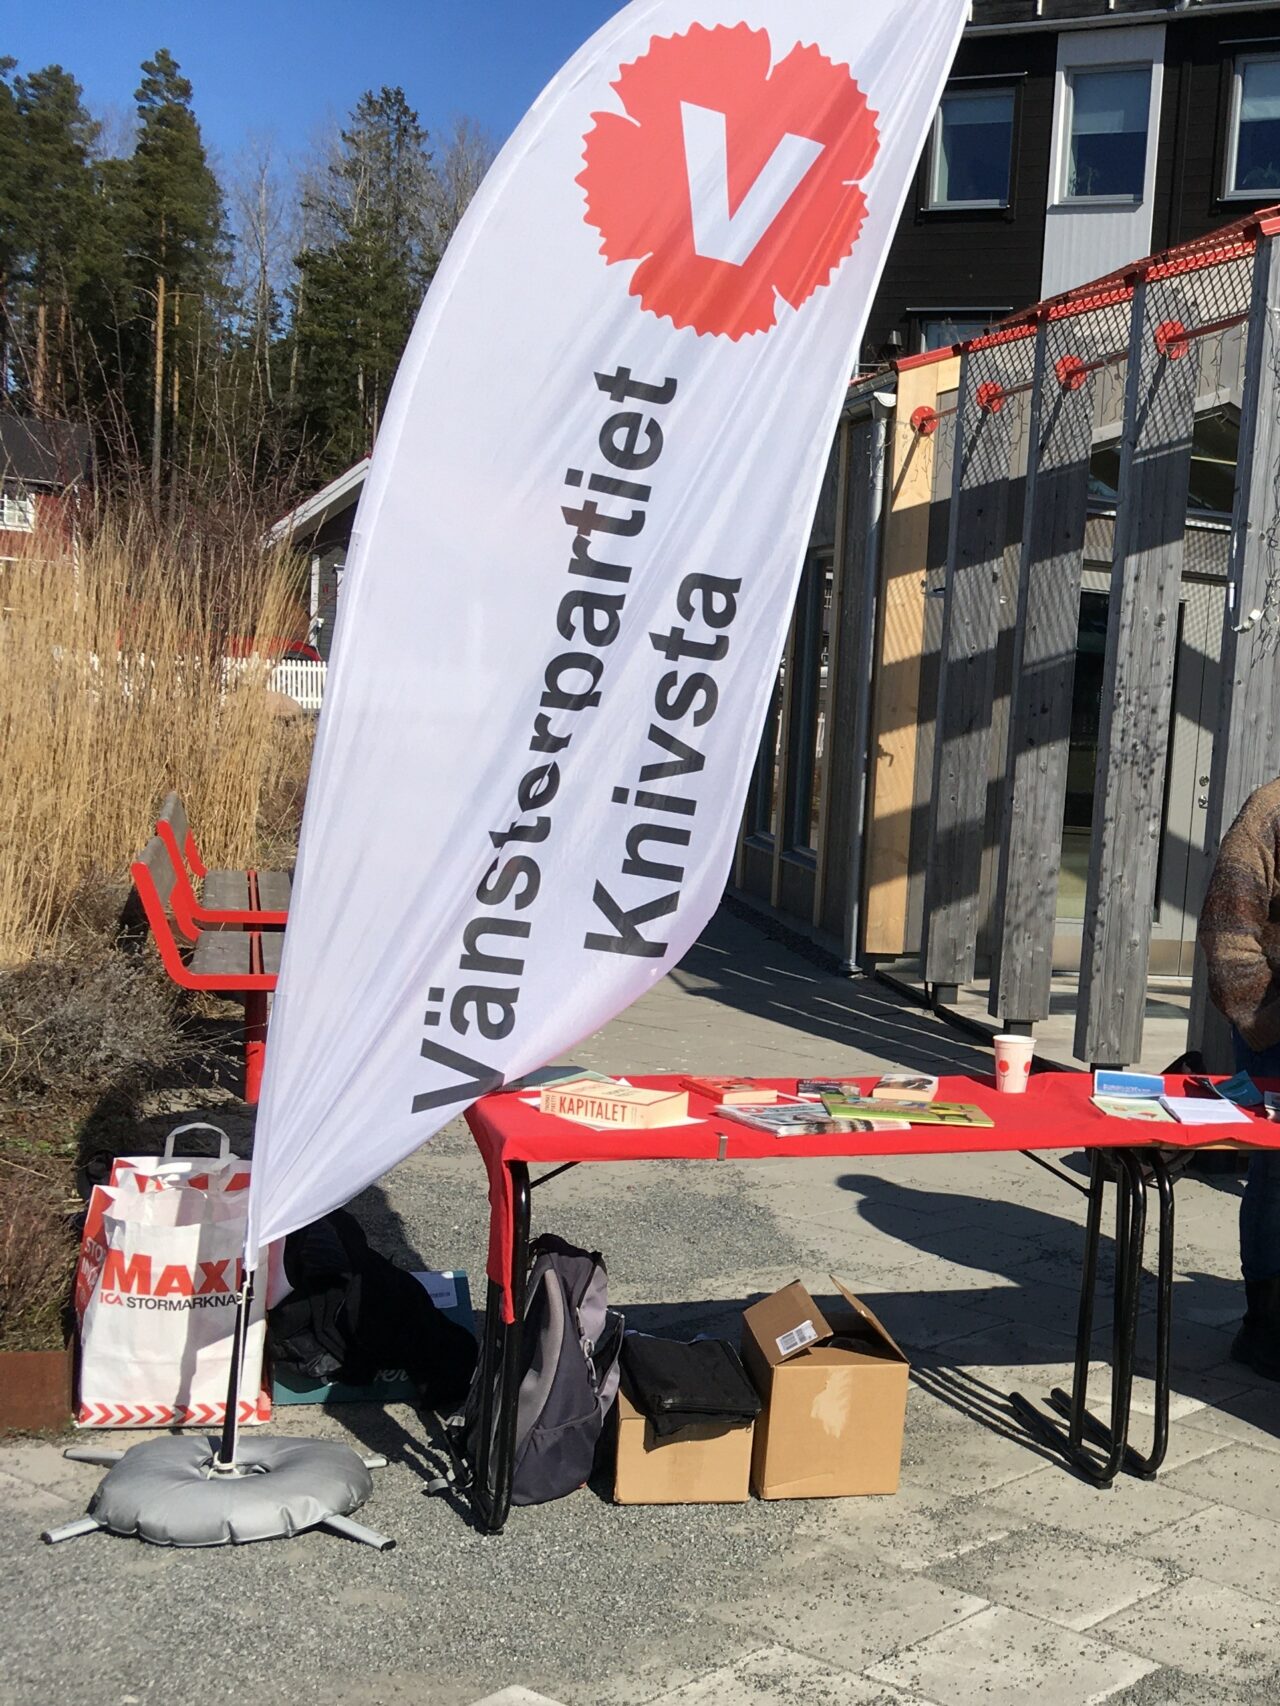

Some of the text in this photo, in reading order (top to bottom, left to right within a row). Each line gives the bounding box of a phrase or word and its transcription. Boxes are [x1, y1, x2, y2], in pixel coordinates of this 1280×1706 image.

[680, 100, 826, 267] V
[412, 365, 677, 1113] Vänsterpartiet
[584, 570, 742, 957] Knivsta
[559, 1096, 628, 1122] KAPITALET
[100, 1292, 243, 1311] ICA STORMARKNA
